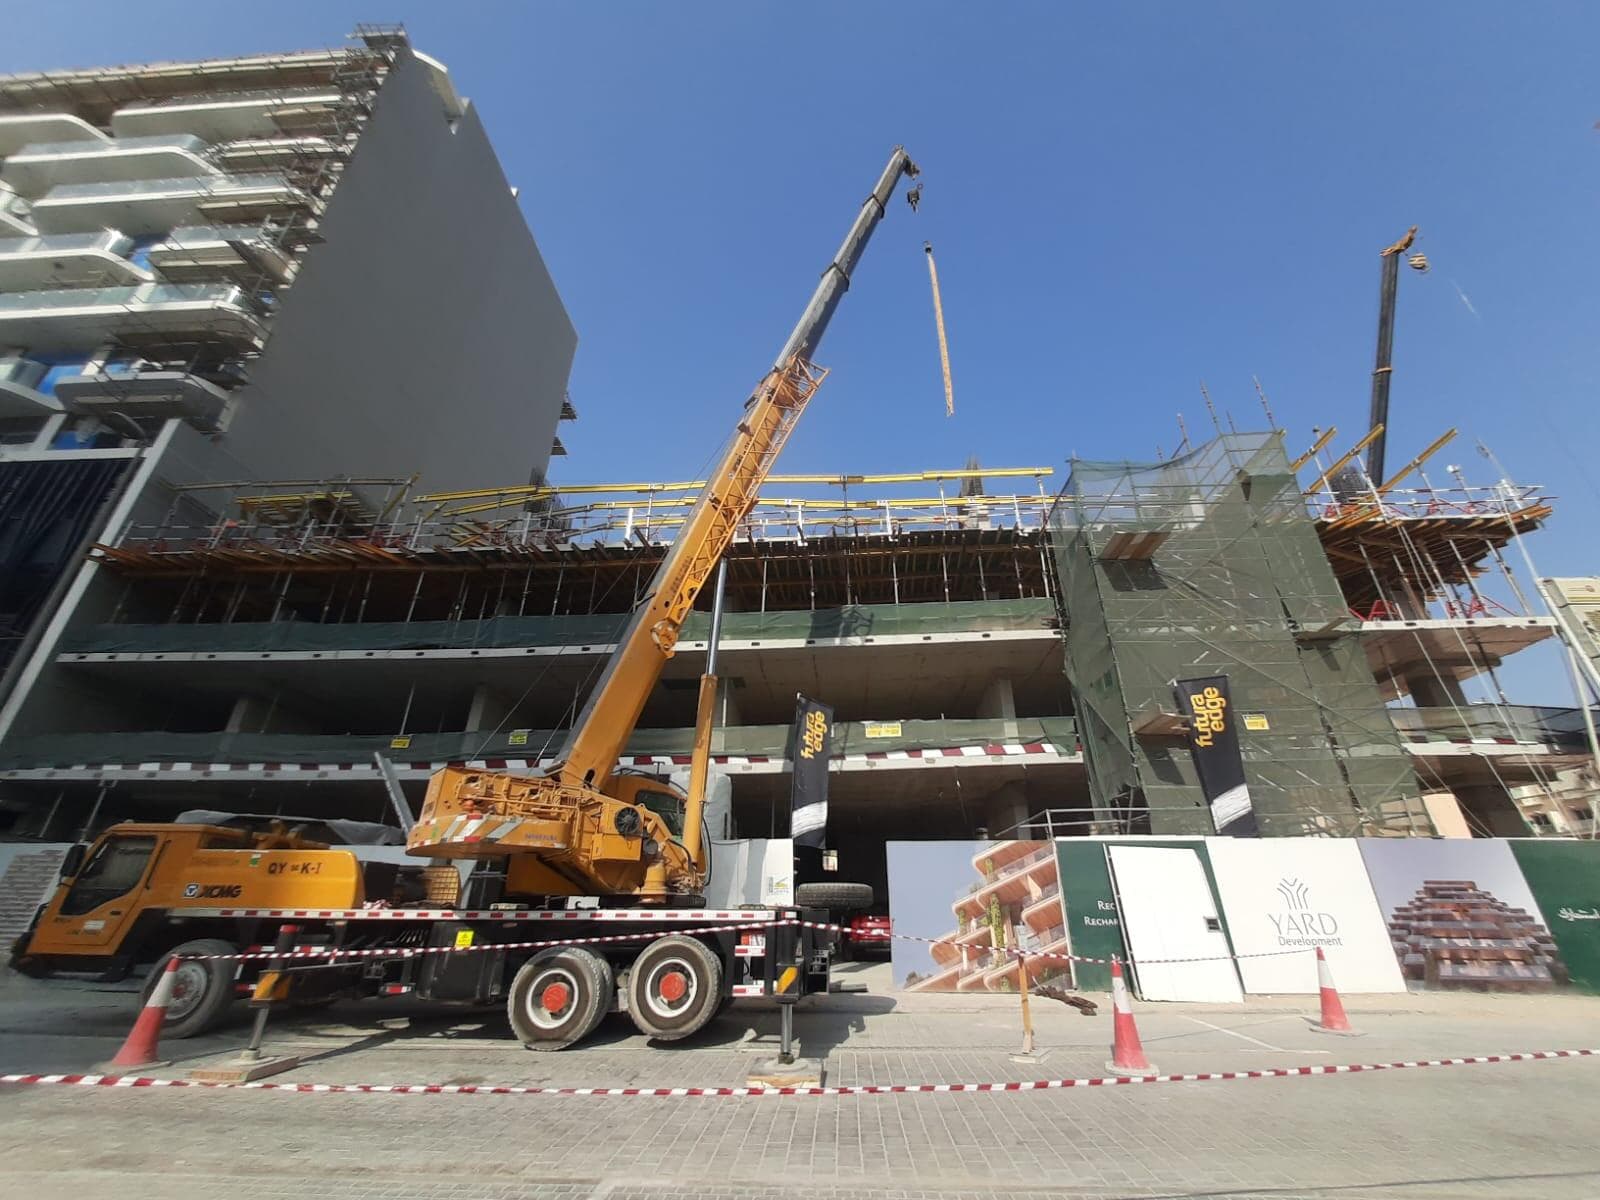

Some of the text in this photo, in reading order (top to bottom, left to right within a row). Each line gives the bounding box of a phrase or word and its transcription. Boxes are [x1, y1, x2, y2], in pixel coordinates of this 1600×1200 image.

[1190, 694, 1214, 748] futura
[1203, 687, 1227, 732] edge
[801, 712, 815, 759] futura
[813, 711, 828, 752] edge
[197, 885, 242, 898] XCMG
[1267, 912, 1338, 936] YARD
[1278, 935, 1343, 946] Development
